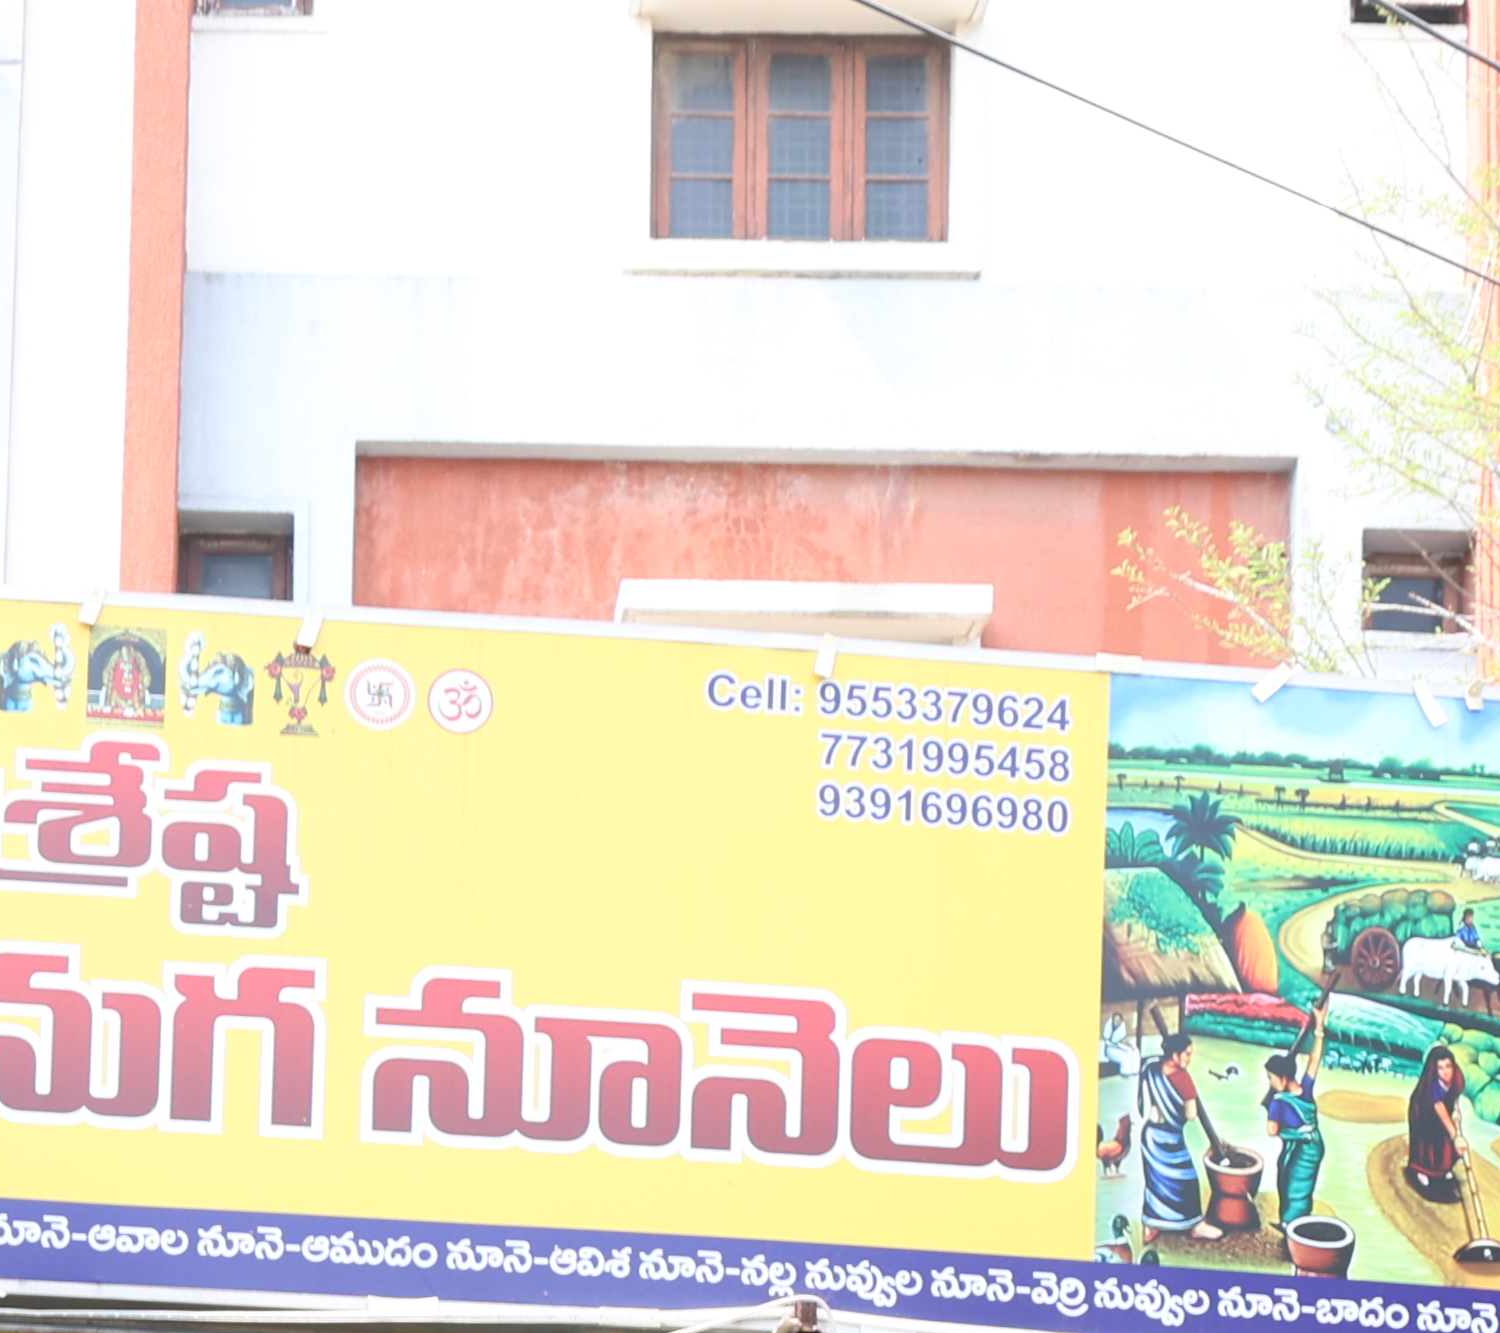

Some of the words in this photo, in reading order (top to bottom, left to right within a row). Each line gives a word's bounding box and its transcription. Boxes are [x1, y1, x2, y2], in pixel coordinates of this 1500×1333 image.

[707, 673, 802, 712] Cell:
[819, 681, 1070, 731] 9553379624
[821, 733, 1070, 782] 7731995458
[818, 784, 1069, 833] 9391696980
[371, 975, 1073, 1175] నూనెలు
[804, 1257, 922, 1307] నువ్వుల
[1094, 1278, 1210, 1326] నువ్వుల
